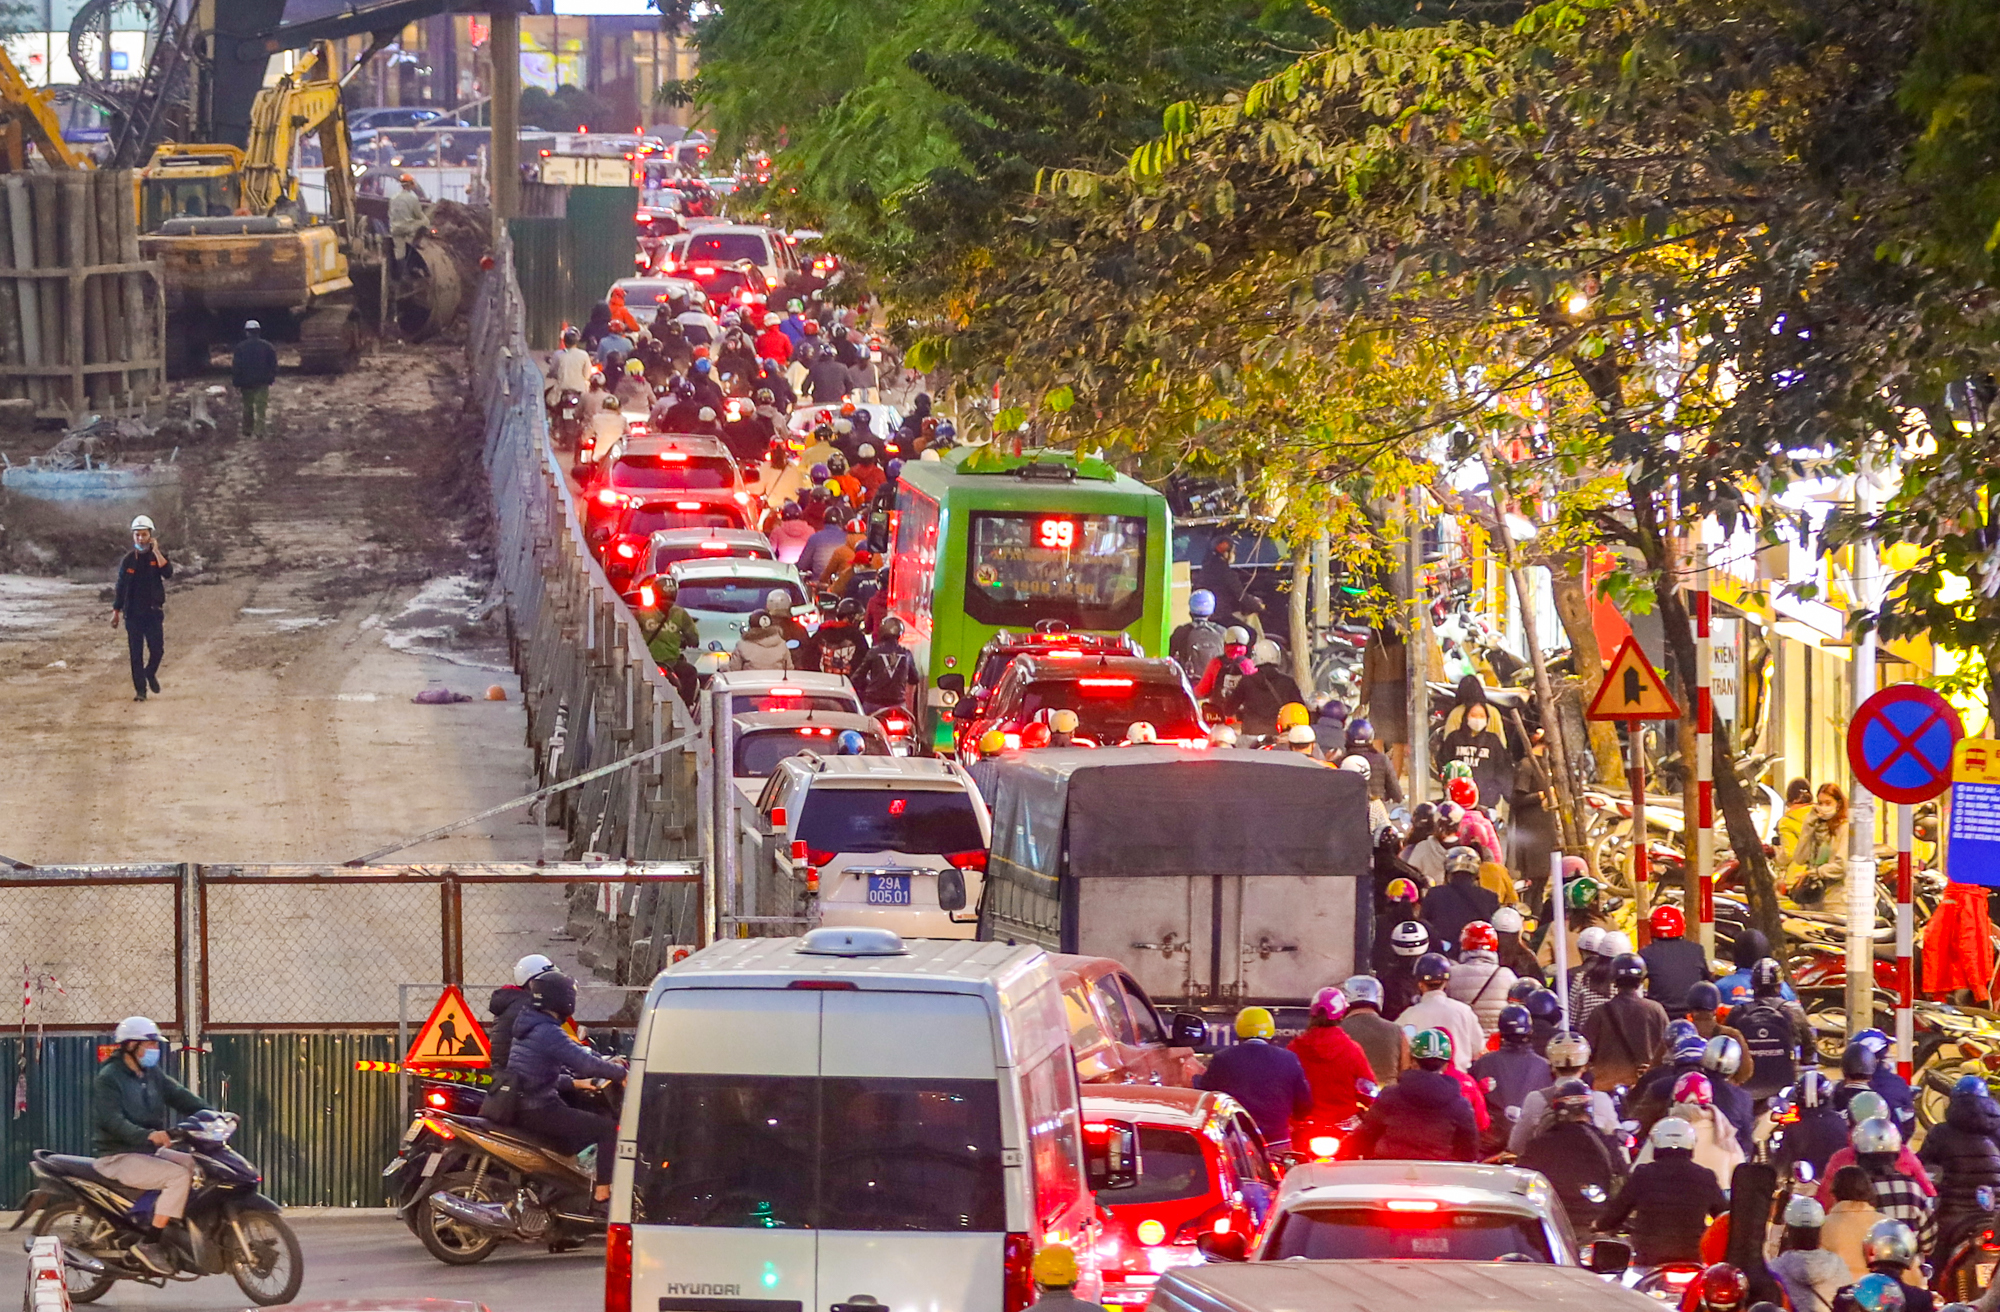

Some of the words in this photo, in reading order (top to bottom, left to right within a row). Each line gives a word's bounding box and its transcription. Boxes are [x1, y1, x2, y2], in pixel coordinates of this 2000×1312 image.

[1041, 520, 1073, 547] 99
[878, 653, 906, 679] V
[878, 877, 901, 890] 29A
[869, 889, 909, 904] 005.01
[667, 1282, 741, 1296] HYUNDAI
